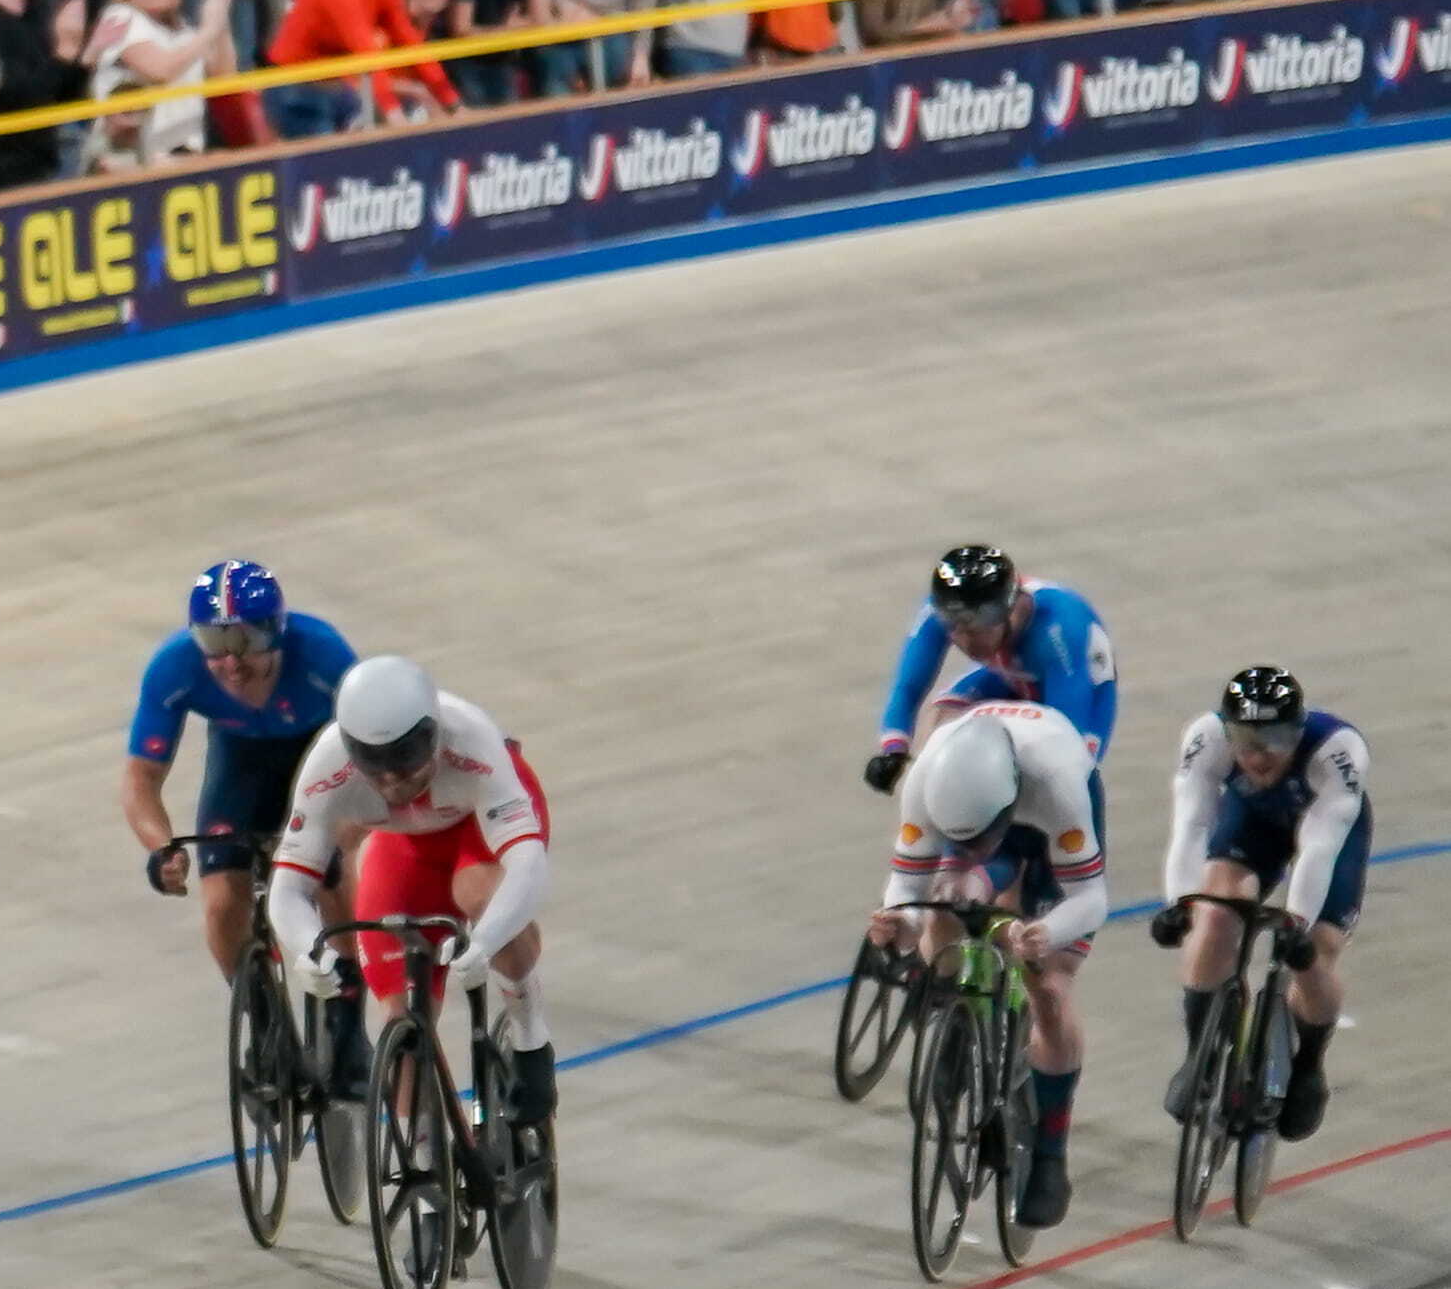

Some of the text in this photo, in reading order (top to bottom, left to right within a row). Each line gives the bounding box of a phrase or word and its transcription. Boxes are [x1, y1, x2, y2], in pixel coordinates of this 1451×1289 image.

[1083, 48, 1199, 119] vittoria
[1245, 23, 1364, 95] vittoria
[770, 95, 876, 168] vittoria
[917, 70, 1033, 142] vittoria
[469, 144, 572, 217] vittoria
[615, 118, 720, 193] vittoria
[323, 168, 423, 243] vittoria
